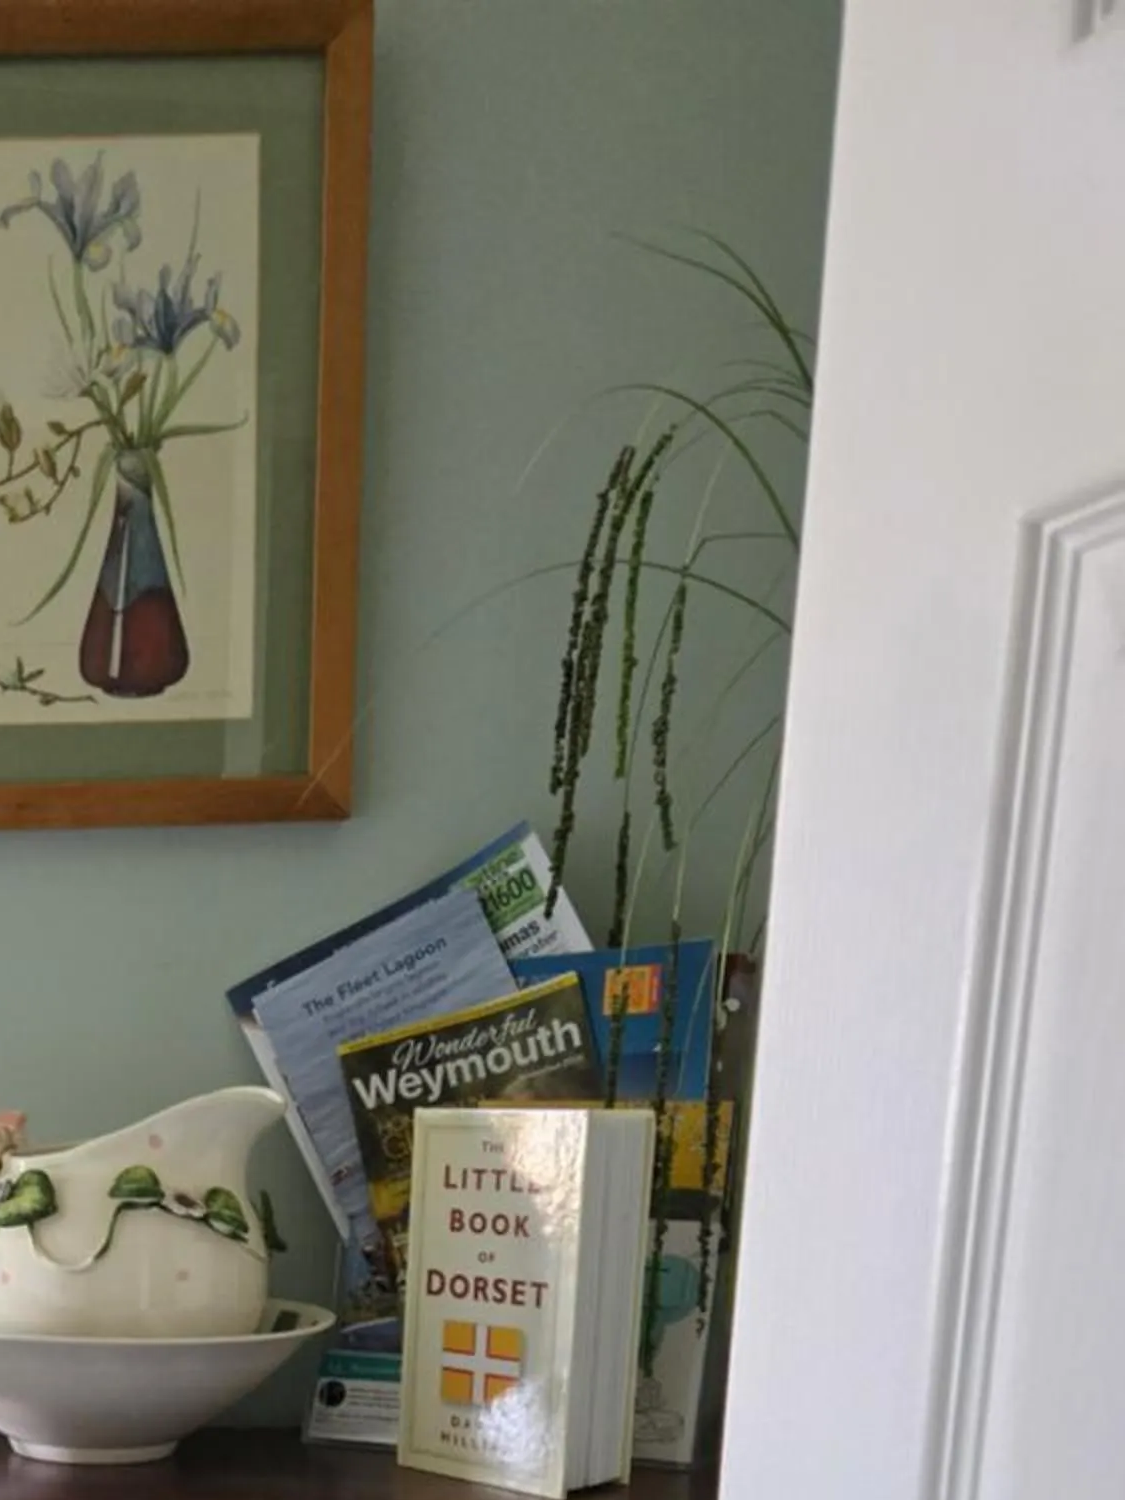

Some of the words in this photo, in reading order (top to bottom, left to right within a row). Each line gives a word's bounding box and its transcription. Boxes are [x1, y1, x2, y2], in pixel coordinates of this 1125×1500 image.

[302, 993, 334, 1016] The
[336, 970, 380, 1000] Fleet
[381, 937, 448, 976] Lagoon
[353, 1018, 583, 1110] Weymouth
[393, 1008, 539, 1071] Wonderful
[450, 1207, 530, 1238] BOOK
[426, 1269, 548, 1309] DORSET
